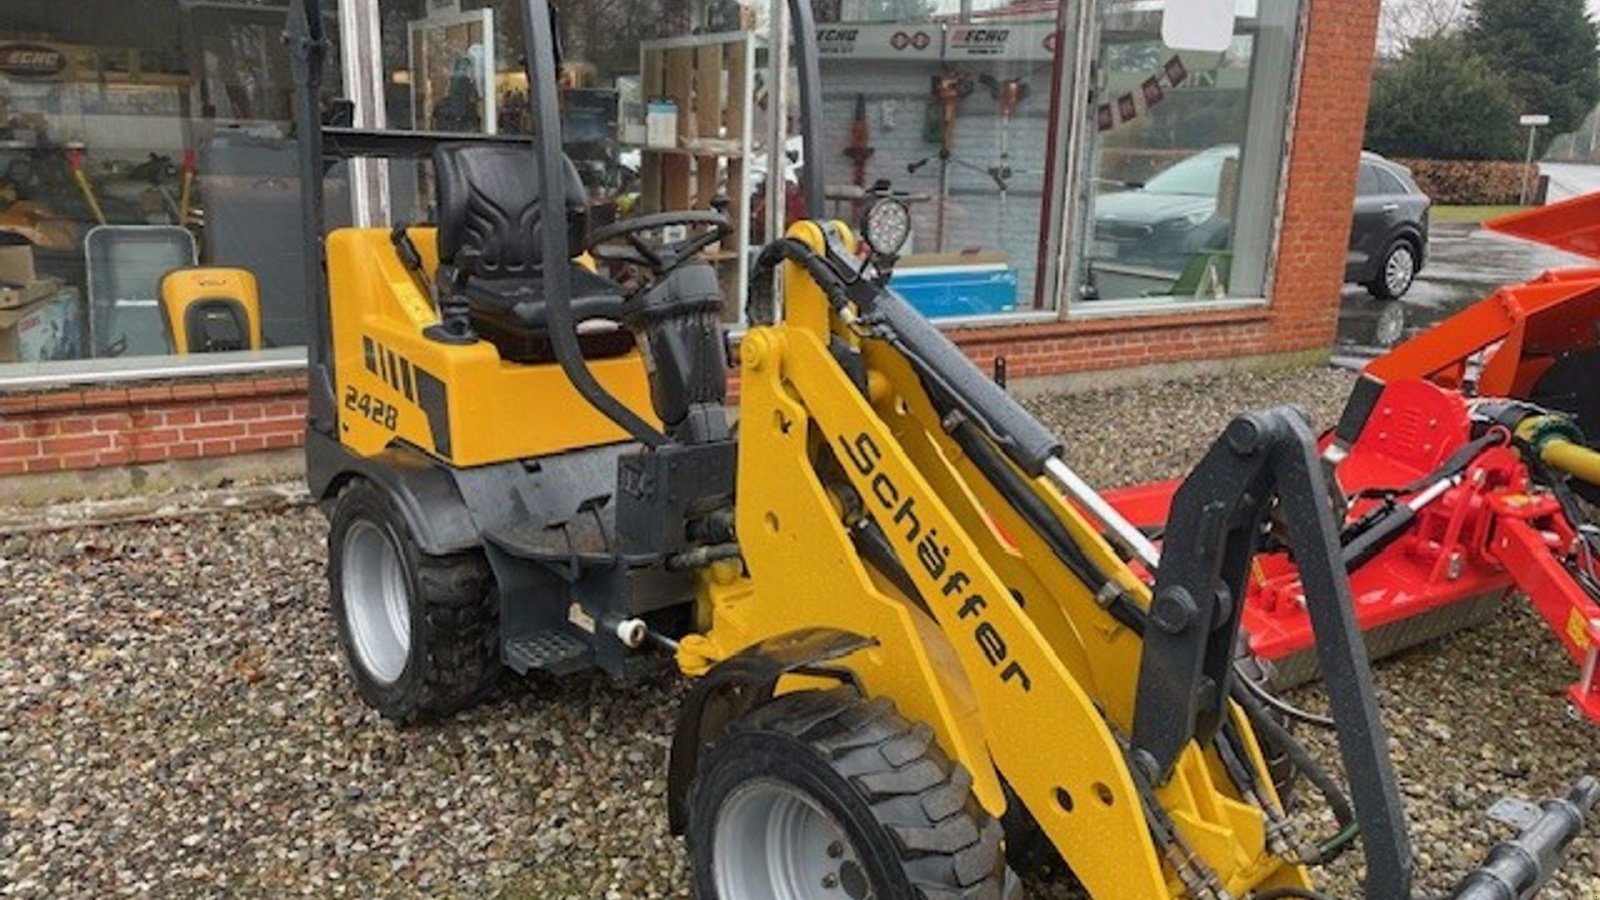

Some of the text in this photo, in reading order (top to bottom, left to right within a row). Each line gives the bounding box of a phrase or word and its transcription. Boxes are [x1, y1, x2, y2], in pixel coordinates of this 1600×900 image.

[817, 29, 858, 41] ECHO
[965, 29, 1009, 41] ECHO
[345, 385, 399, 431] 2428
[839, 432, 1031, 692] Schäffer
